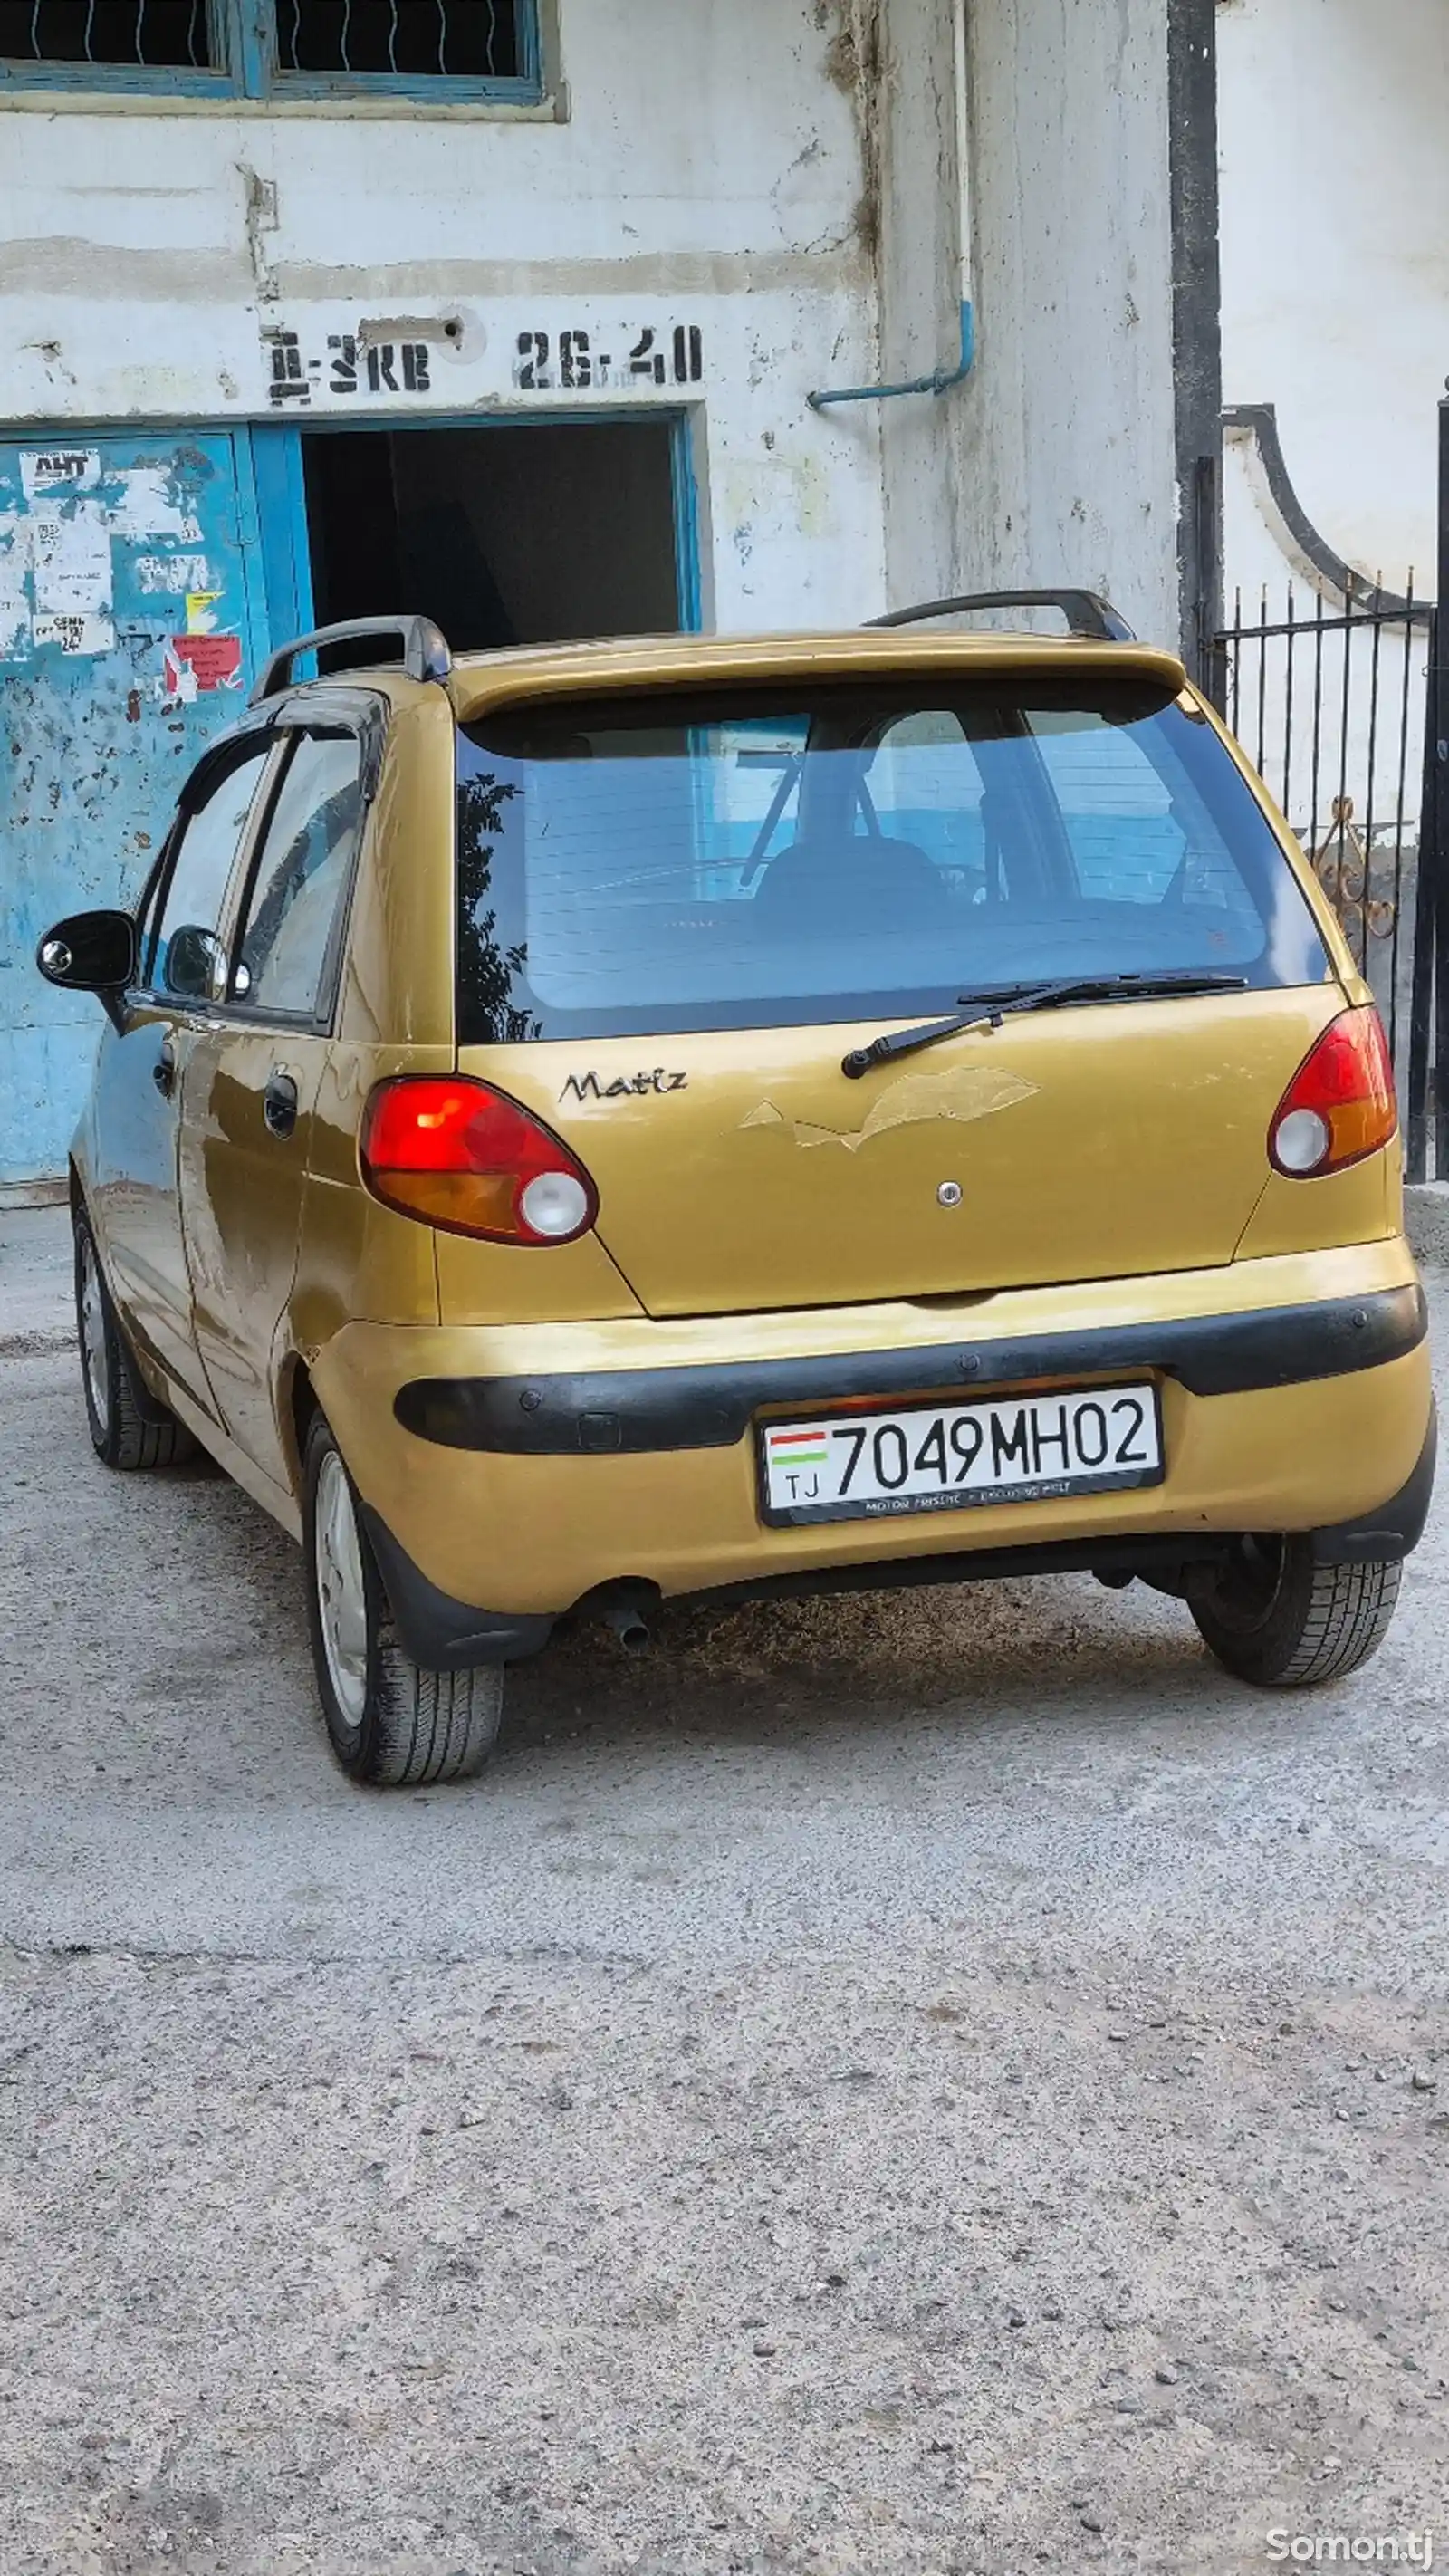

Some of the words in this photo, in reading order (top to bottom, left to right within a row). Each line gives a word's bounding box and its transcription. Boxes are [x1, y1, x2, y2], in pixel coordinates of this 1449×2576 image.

[558, 1067, 689, 1103] Matiz
[831, 1398, 1147, 1495] 7049MH02
[785, 1473, 819, 1499] TJ
